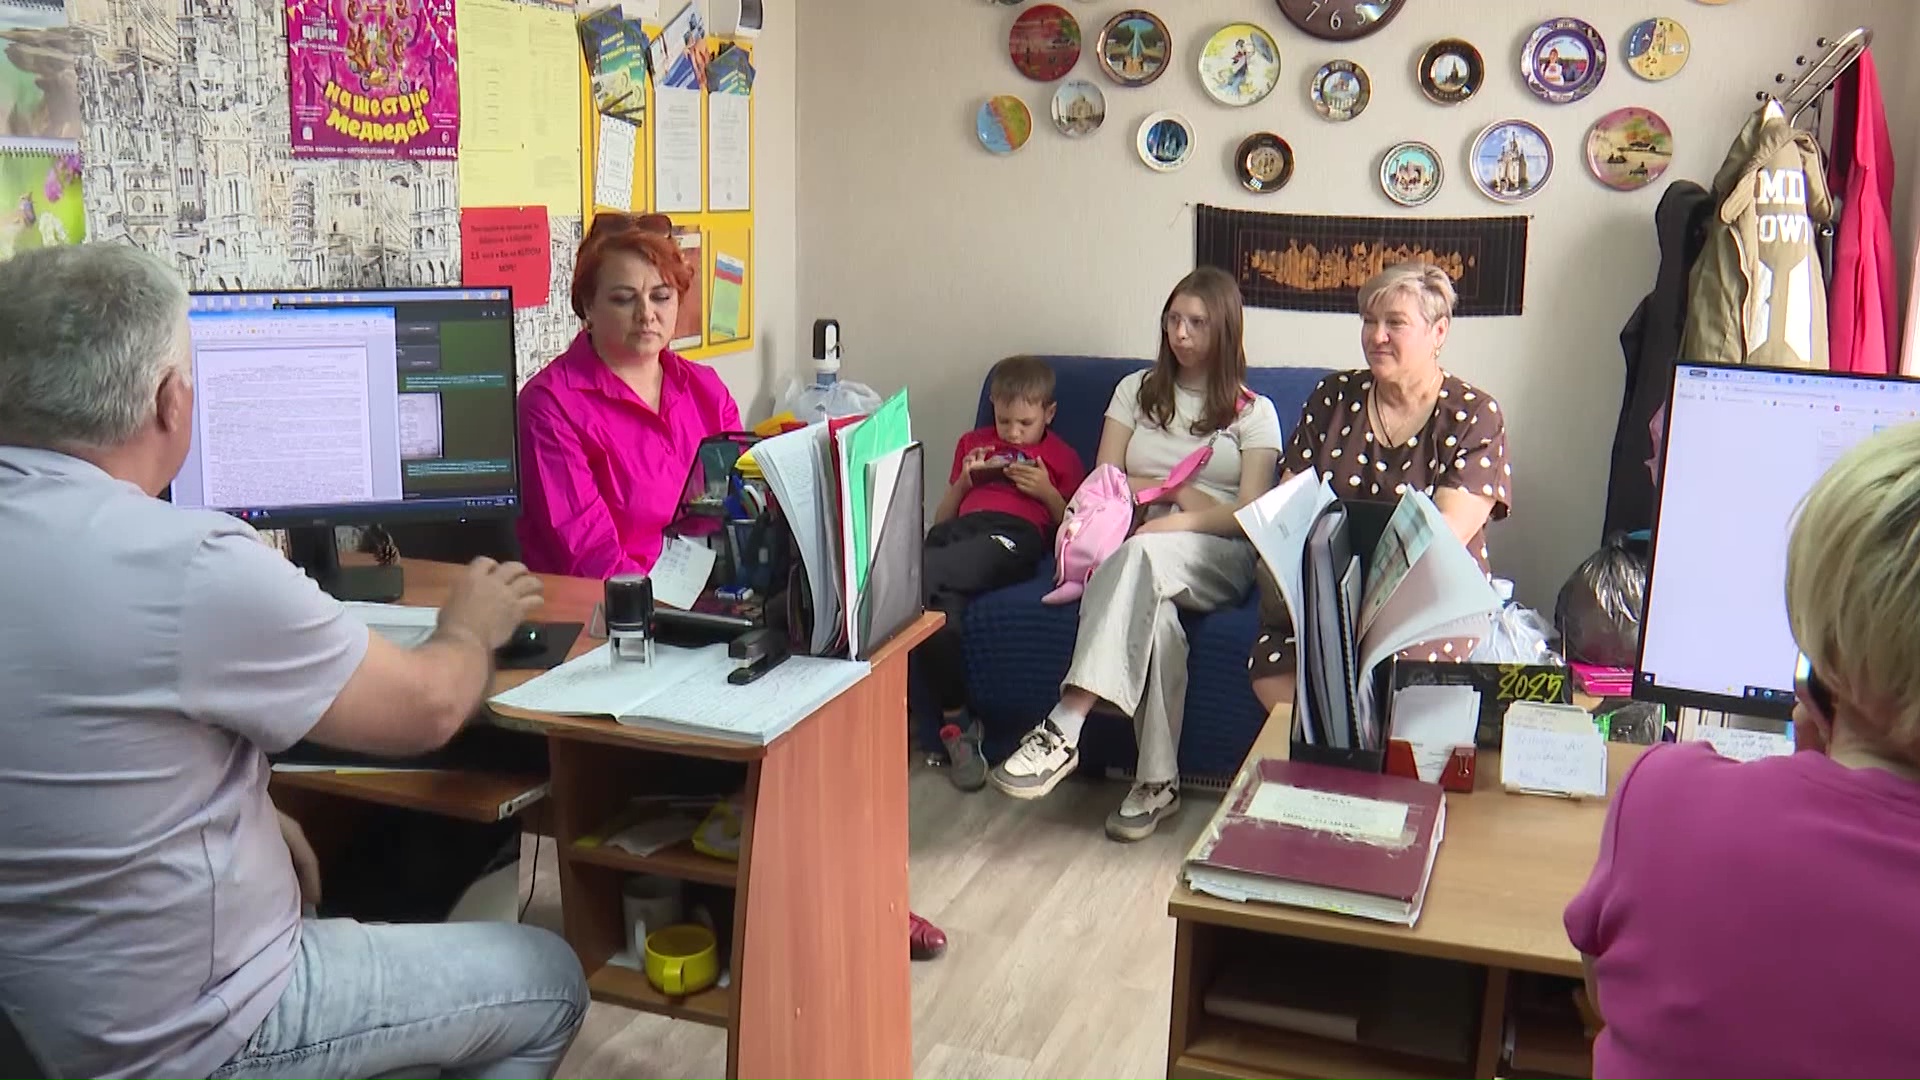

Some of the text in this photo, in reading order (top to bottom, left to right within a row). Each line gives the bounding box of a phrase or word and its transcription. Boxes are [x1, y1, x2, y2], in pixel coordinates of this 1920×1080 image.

[1306, 1, 1366, 30] 7 6 5
[1496, 671, 1565, 704] 2025
